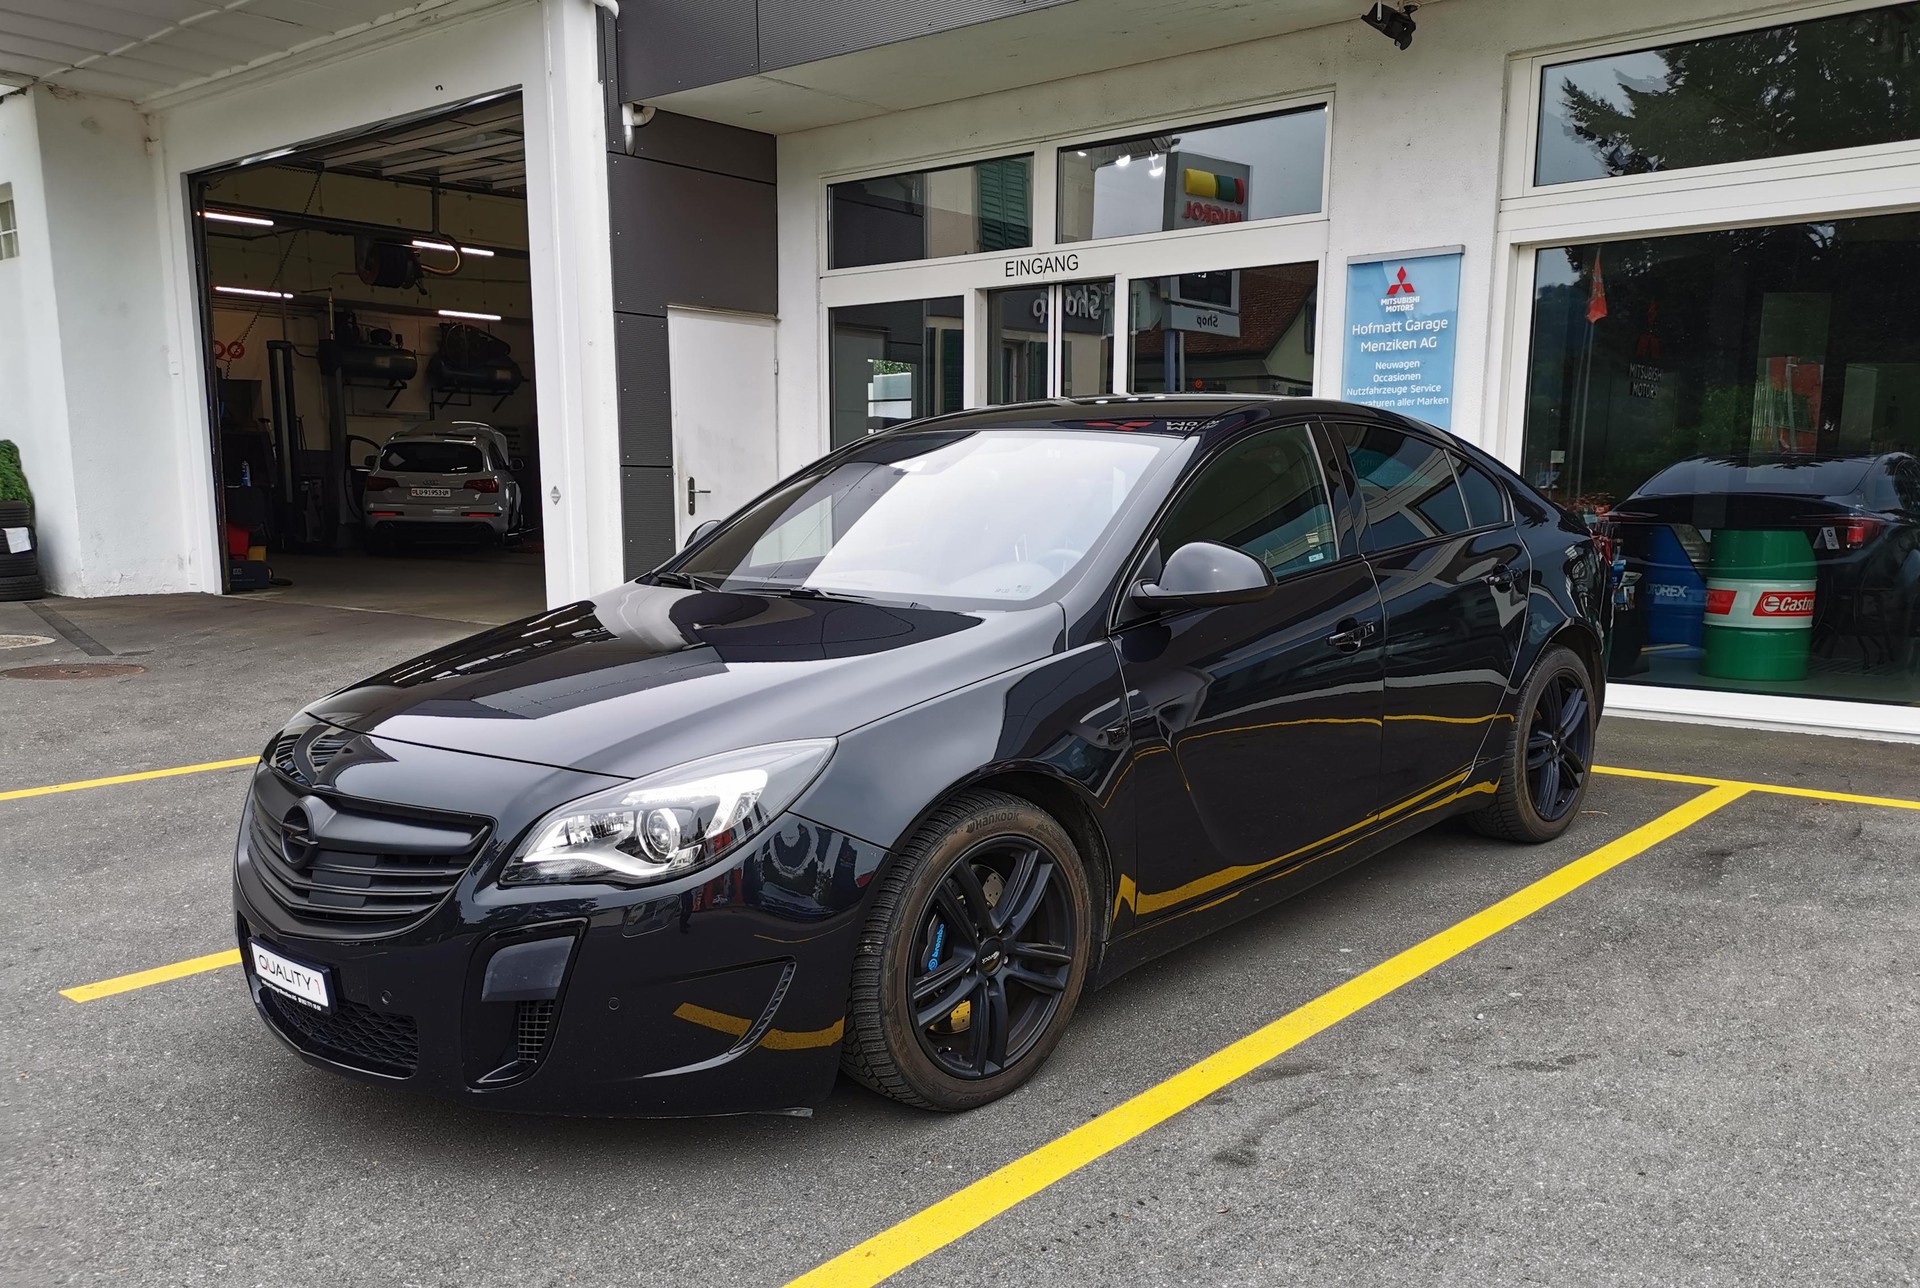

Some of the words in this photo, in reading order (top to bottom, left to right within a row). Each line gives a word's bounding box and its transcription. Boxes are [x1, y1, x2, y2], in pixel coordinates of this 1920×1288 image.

[1005, 254, 1079, 277] EINGANG
[1380, 296, 1420, 305] MITSUBISHI
[1385, 304, 1415, 312] MOTORS
[1352, 321, 1402, 335] Hofmatt
[1405, 319, 1449, 332] Garage
[1360, 339, 1417, 353] Menziken
[1420, 337, 1437, 348] AG
[1375, 360, 1420, 370] Neuwagen
[1373, 373, 1421, 383] Occasionen
[1346, 386, 1408, 396] Nutzfahrzeuge
[1410, 384, 1441, 394] Service
[1397, 398, 1415, 407] aller
[1417, 397, 1449, 406] Marken
[931, 923, 945, 958] brembo
